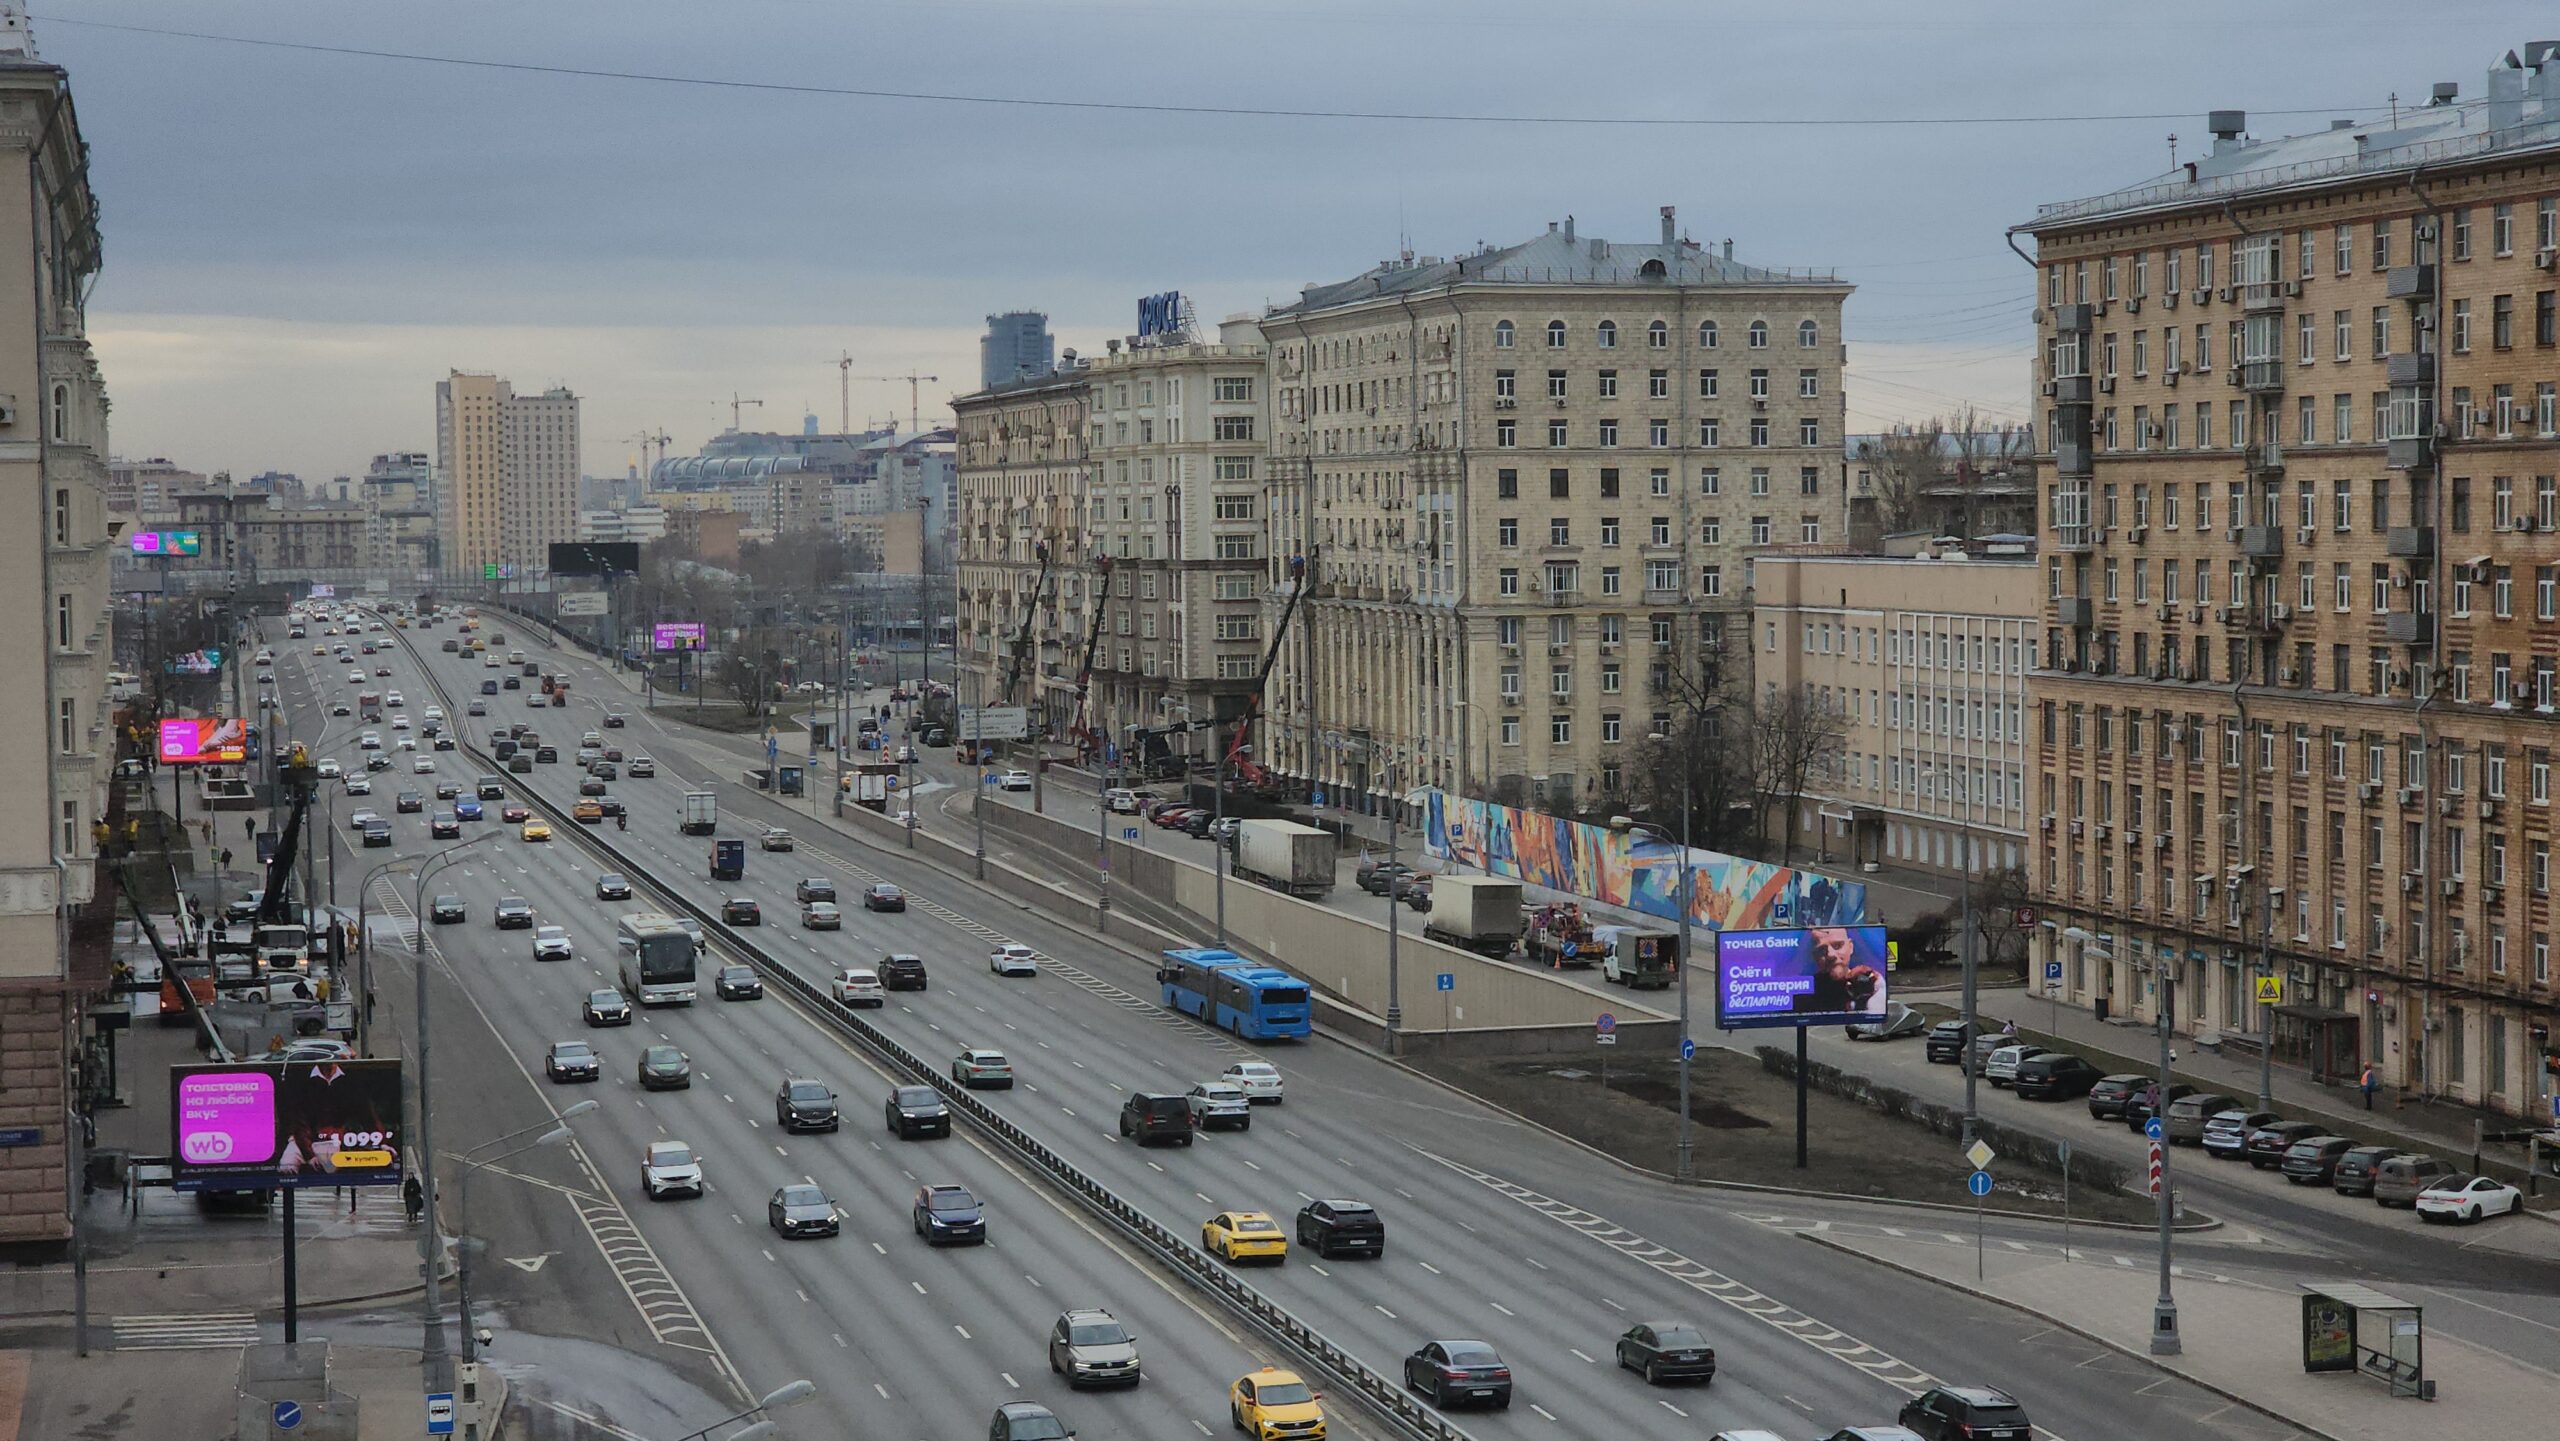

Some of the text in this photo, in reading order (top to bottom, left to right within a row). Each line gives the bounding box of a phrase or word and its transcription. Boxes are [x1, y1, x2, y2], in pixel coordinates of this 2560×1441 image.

[1138, 290, 1179, 336] КРОСТ
[1777, 905, 1786, 917] P
[1724, 936, 1799, 949] точка банк
[1729, 966, 1772, 979] Счёт и
[2049, 963, 2059, 976] P
[1729, 979, 1810, 995] бухгалтерия
[1729, 993, 1790, 1008] бесплатно
[186, 1082, 259, 1092] толстовка
[186, 1092, 254, 1106] на любой
[186, 1110, 219, 1120] вкус
[191, 1135, 227, 1154] wb
